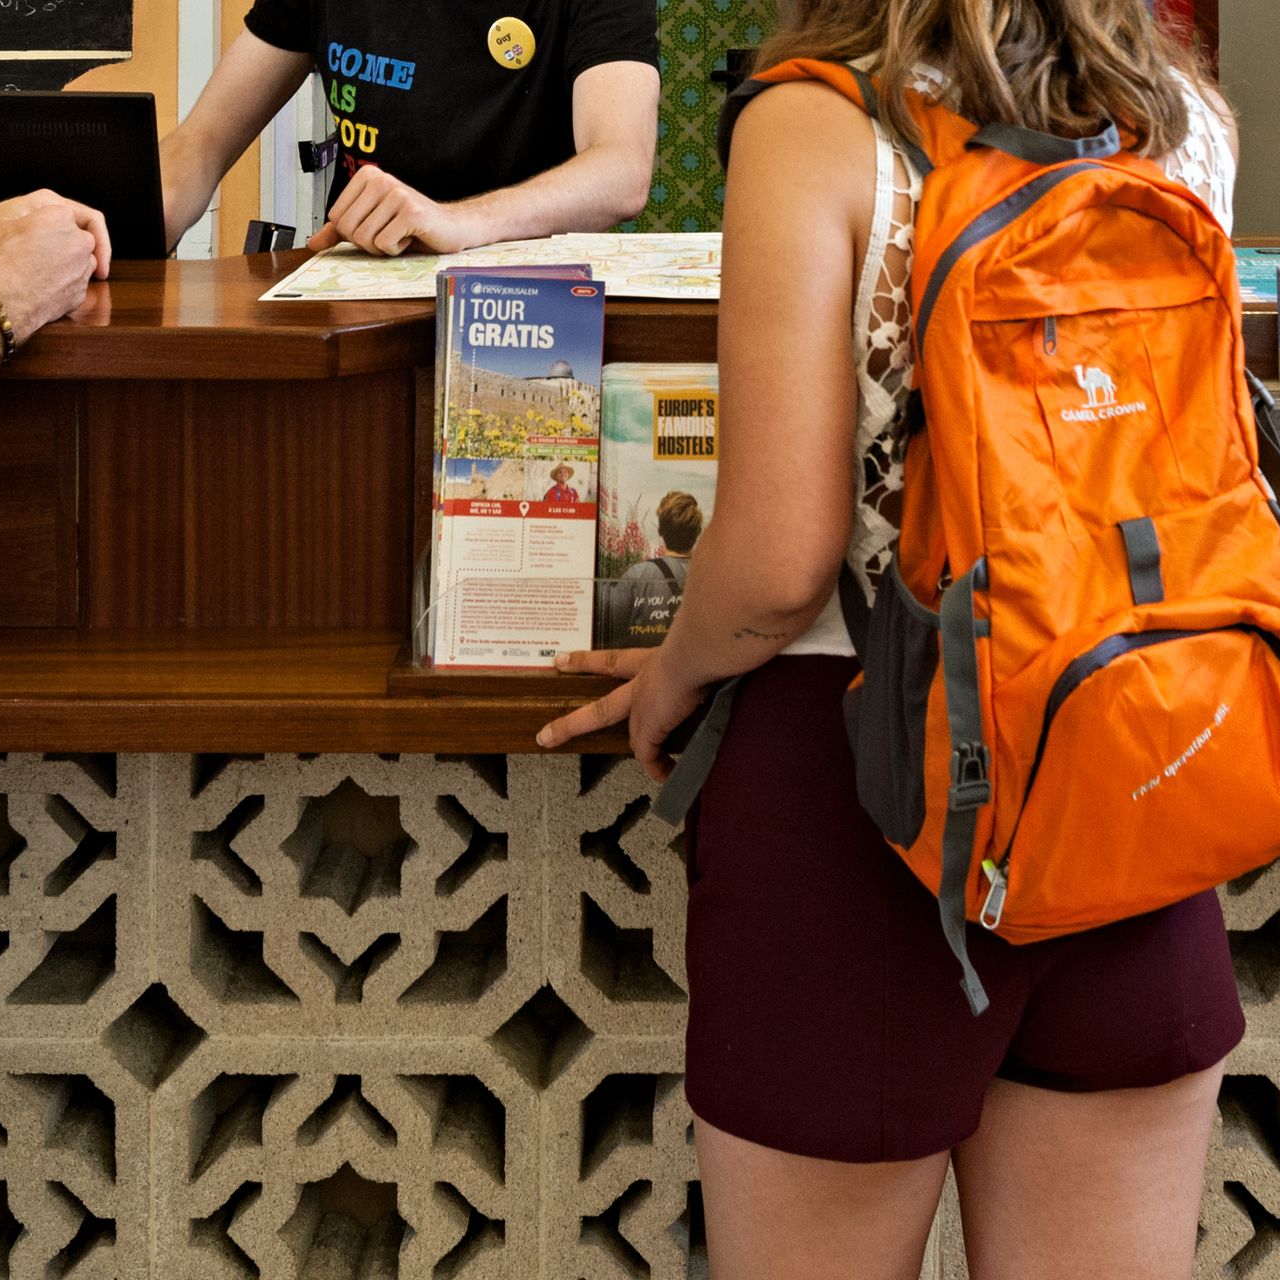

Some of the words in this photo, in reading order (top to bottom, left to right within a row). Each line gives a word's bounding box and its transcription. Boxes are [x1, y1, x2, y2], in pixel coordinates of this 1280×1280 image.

[496, 33, 511, 46] Guy
[327, 42, 416, 91] COME
[329, 79, 357, 113] AS
[470, 298, 525, 321] TOUR
[468, 322, 554, 349] GRATIS
[658, 399, 714, 417] EUROPE'S
[1098, 401, 1146, 419] CROWN
[658, 417, 715, 437] FAMOUS
[658, 436, 714, 455] HOSTELS
